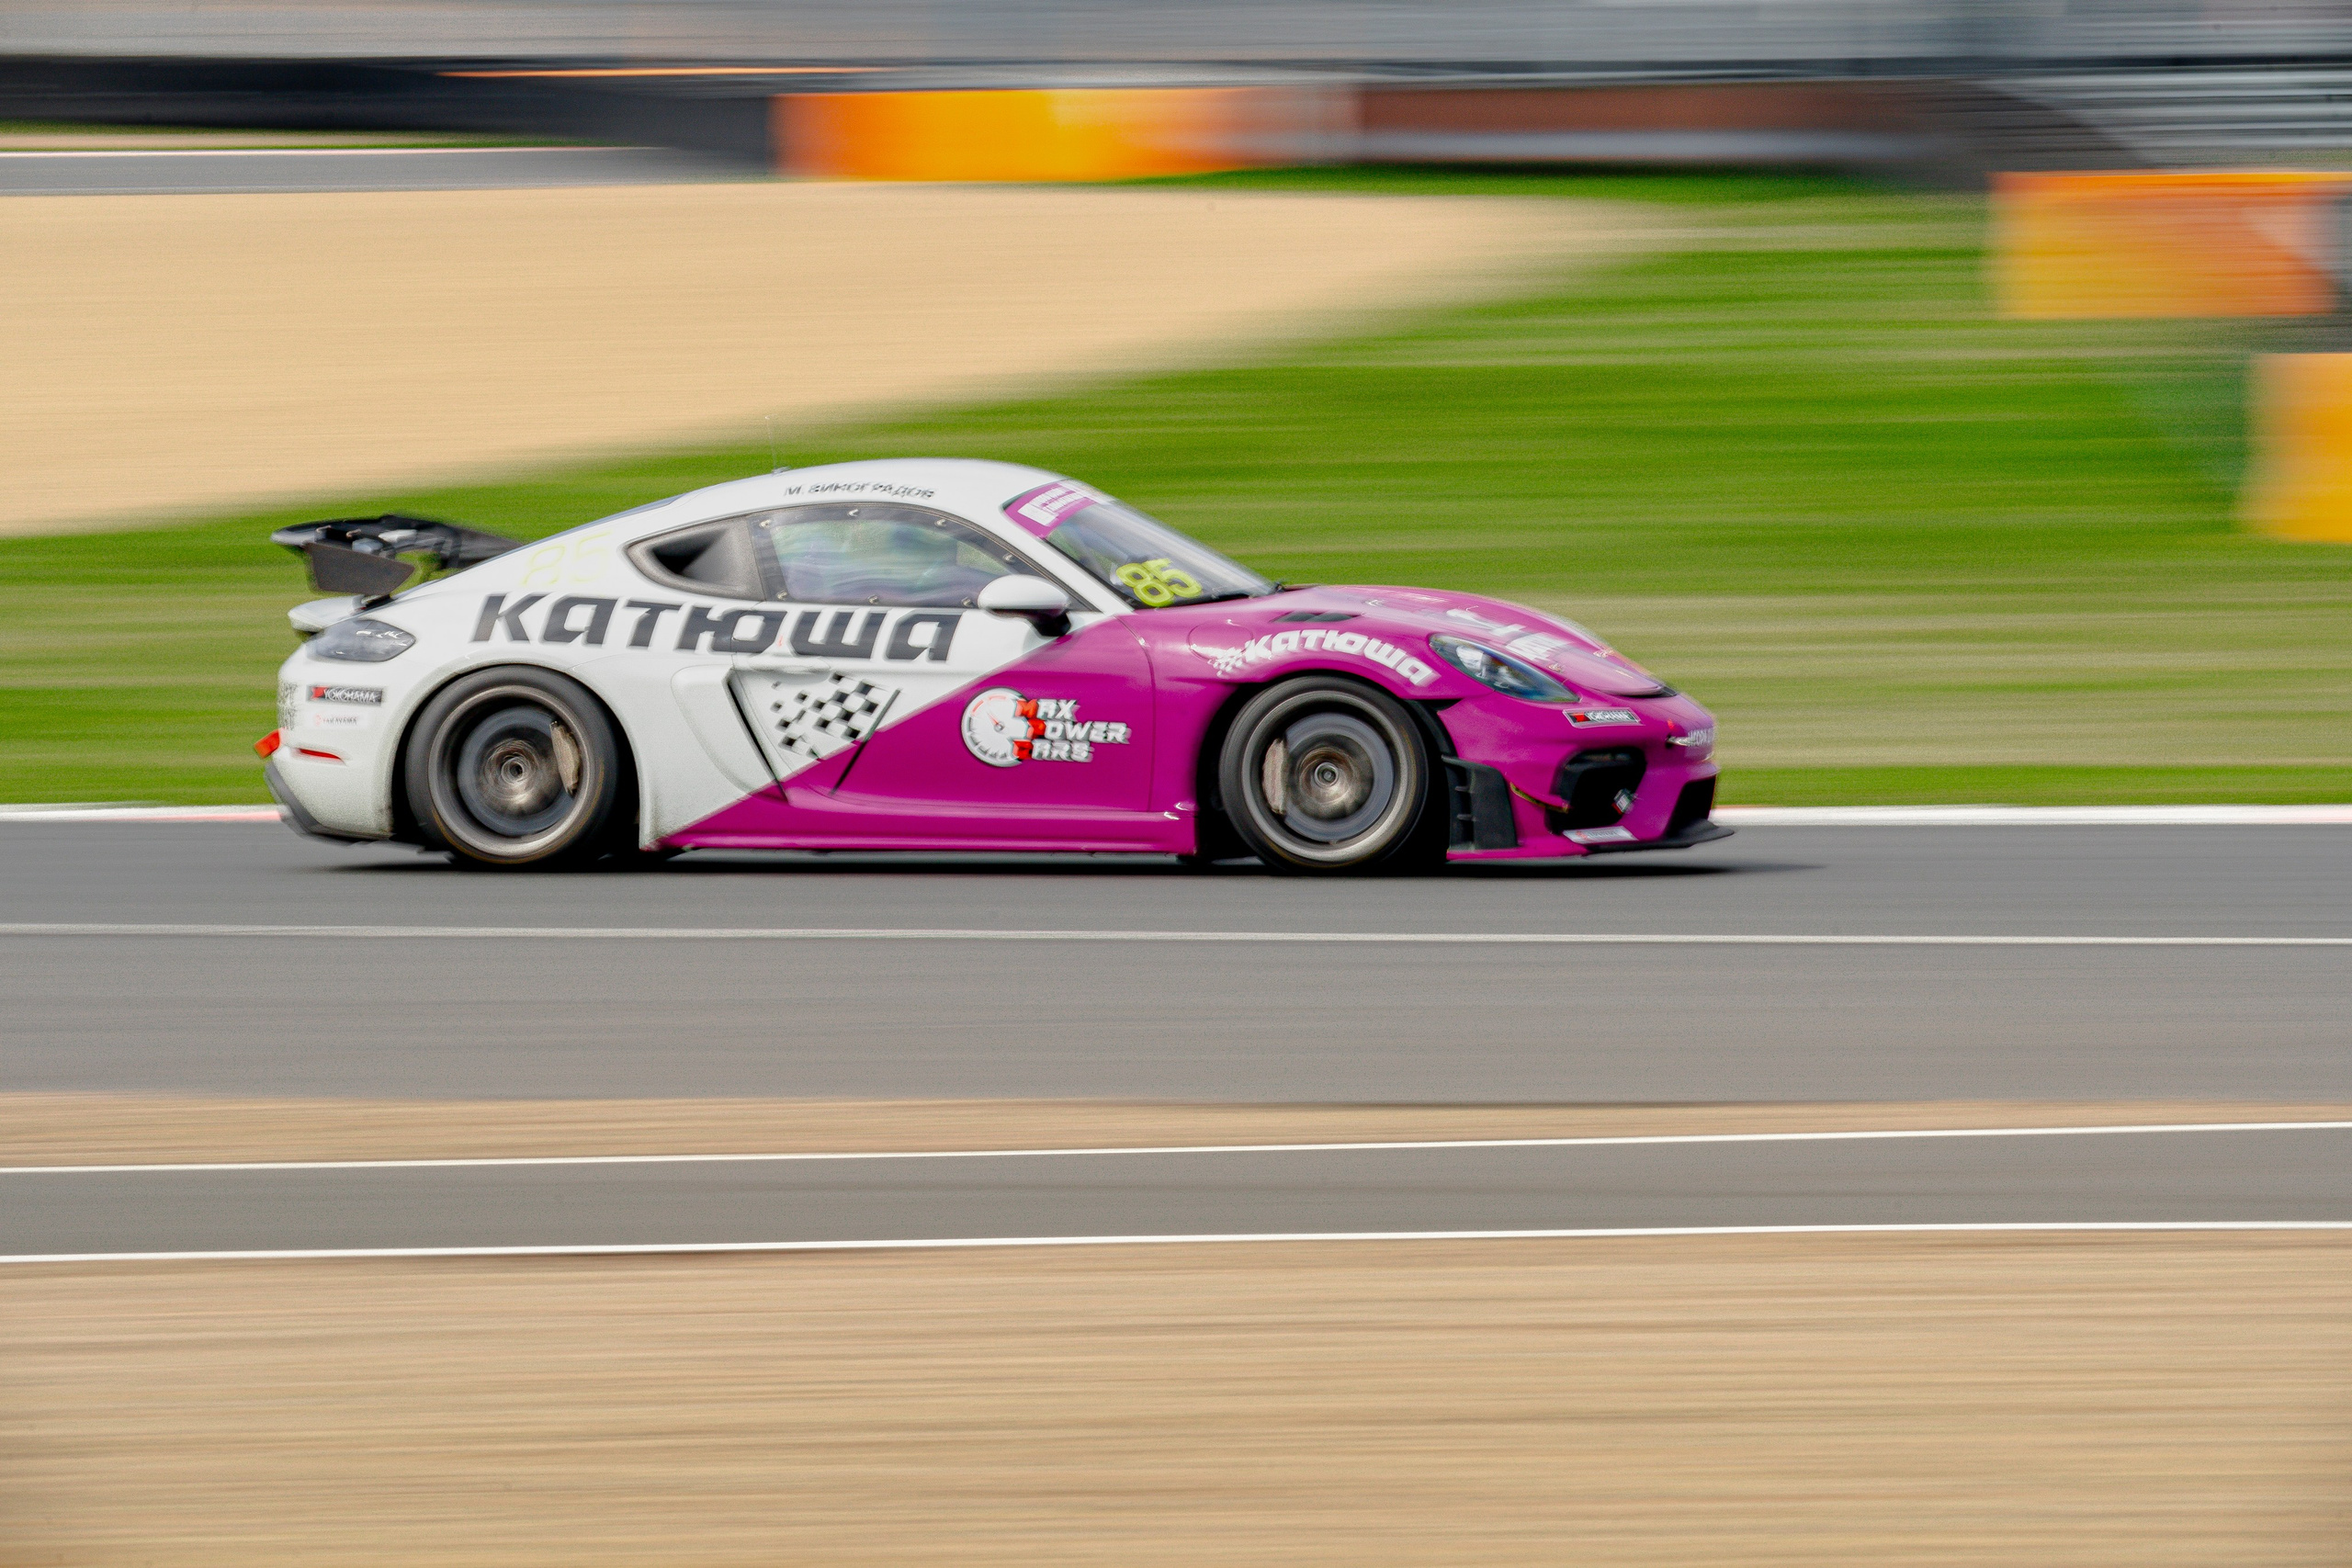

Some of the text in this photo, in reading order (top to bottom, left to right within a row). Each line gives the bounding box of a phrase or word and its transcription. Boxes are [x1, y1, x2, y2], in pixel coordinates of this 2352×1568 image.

[1115, 558, 1203, 607] 85
[323, 688, 379, 703] YOKOHAMA
[1015, 698, 1079, 720] MAX
[1027, 718, 1129, 744] POWER
[1012, 739, 1092, 762] CARS
